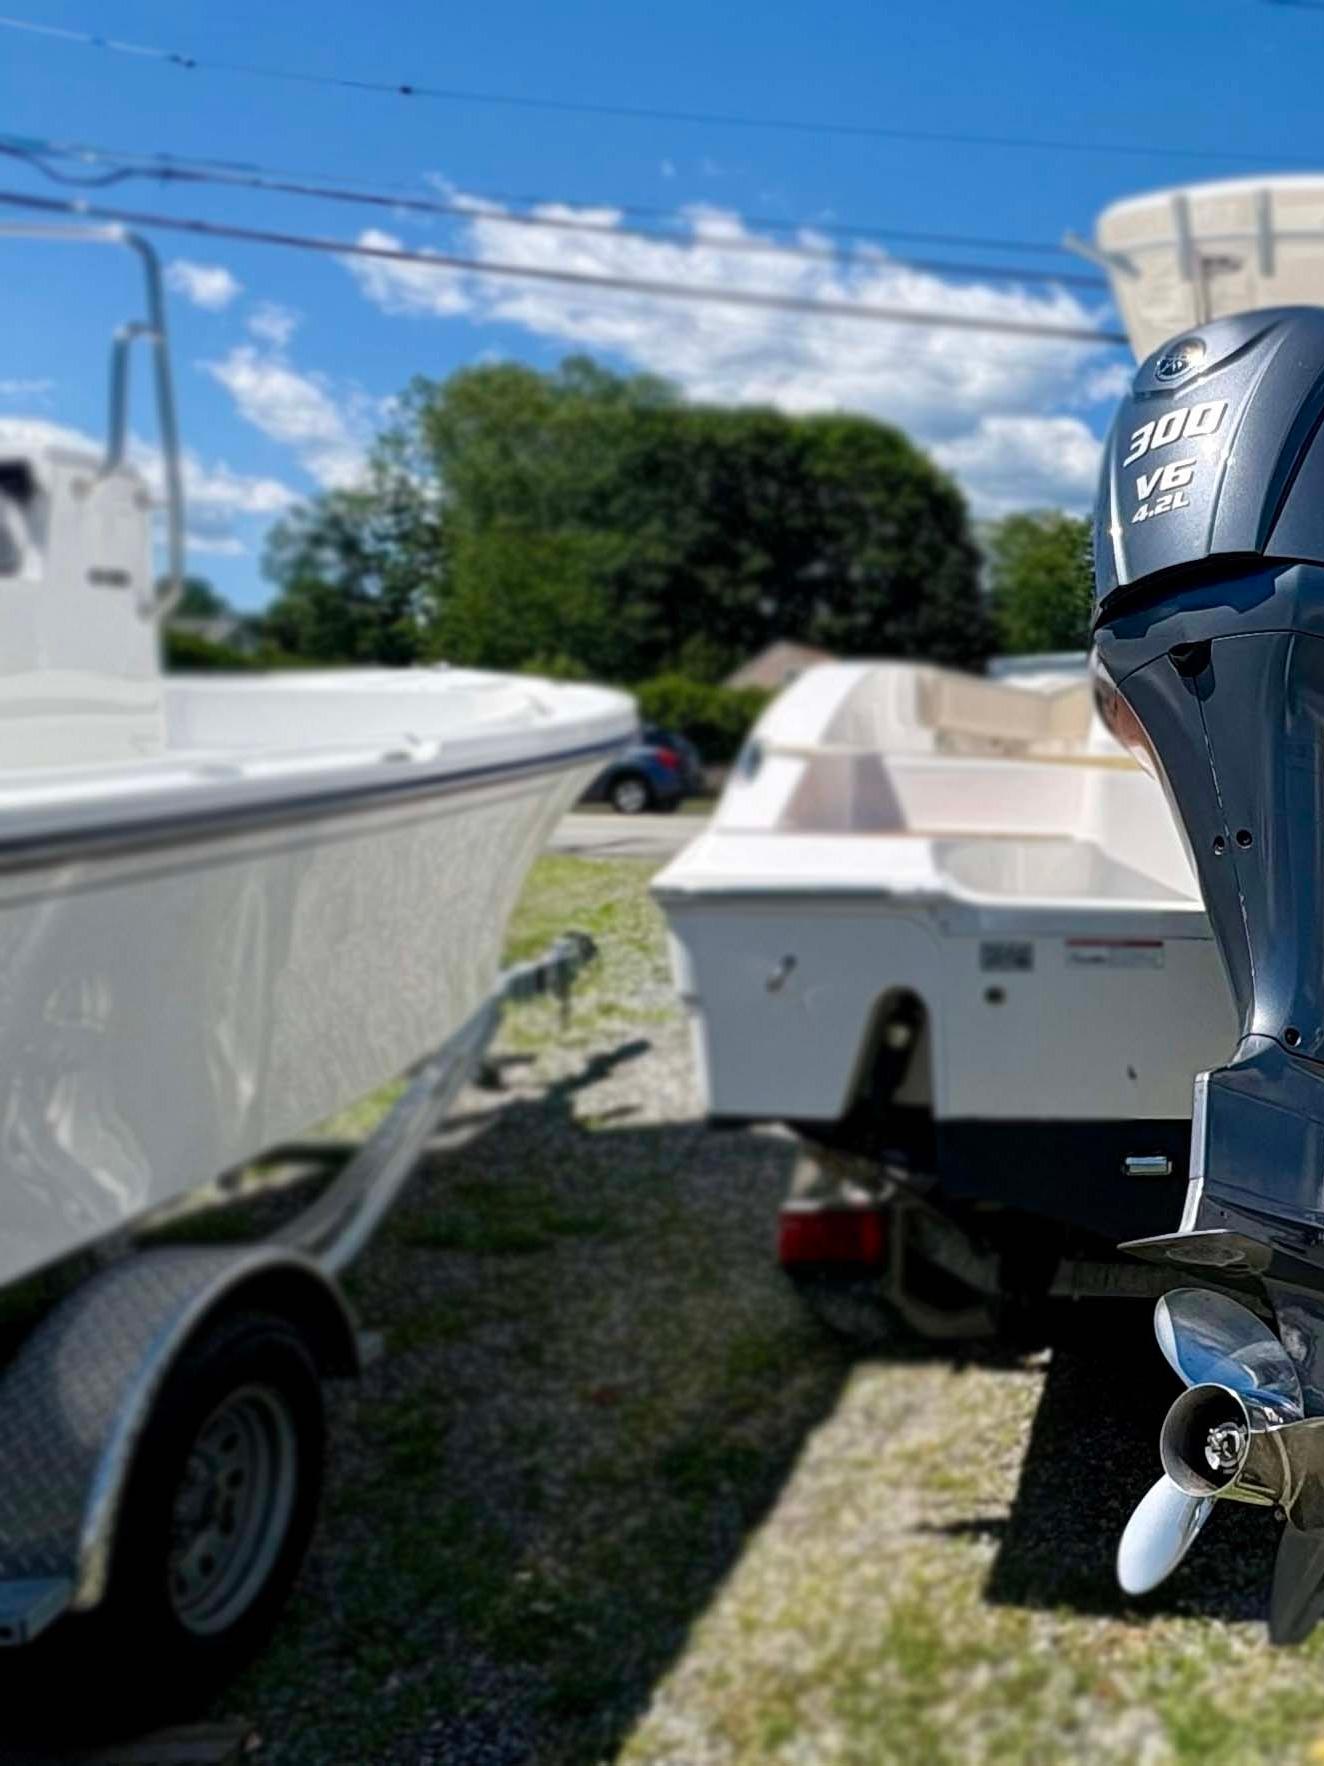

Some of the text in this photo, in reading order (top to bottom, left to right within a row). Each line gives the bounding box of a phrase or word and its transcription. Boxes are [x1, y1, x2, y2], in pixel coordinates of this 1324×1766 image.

[1122, 399, 1228, 468] 300
[1135, 459, 1197, 501] V6
[1131, 491, 1191, 524] 4.2L
